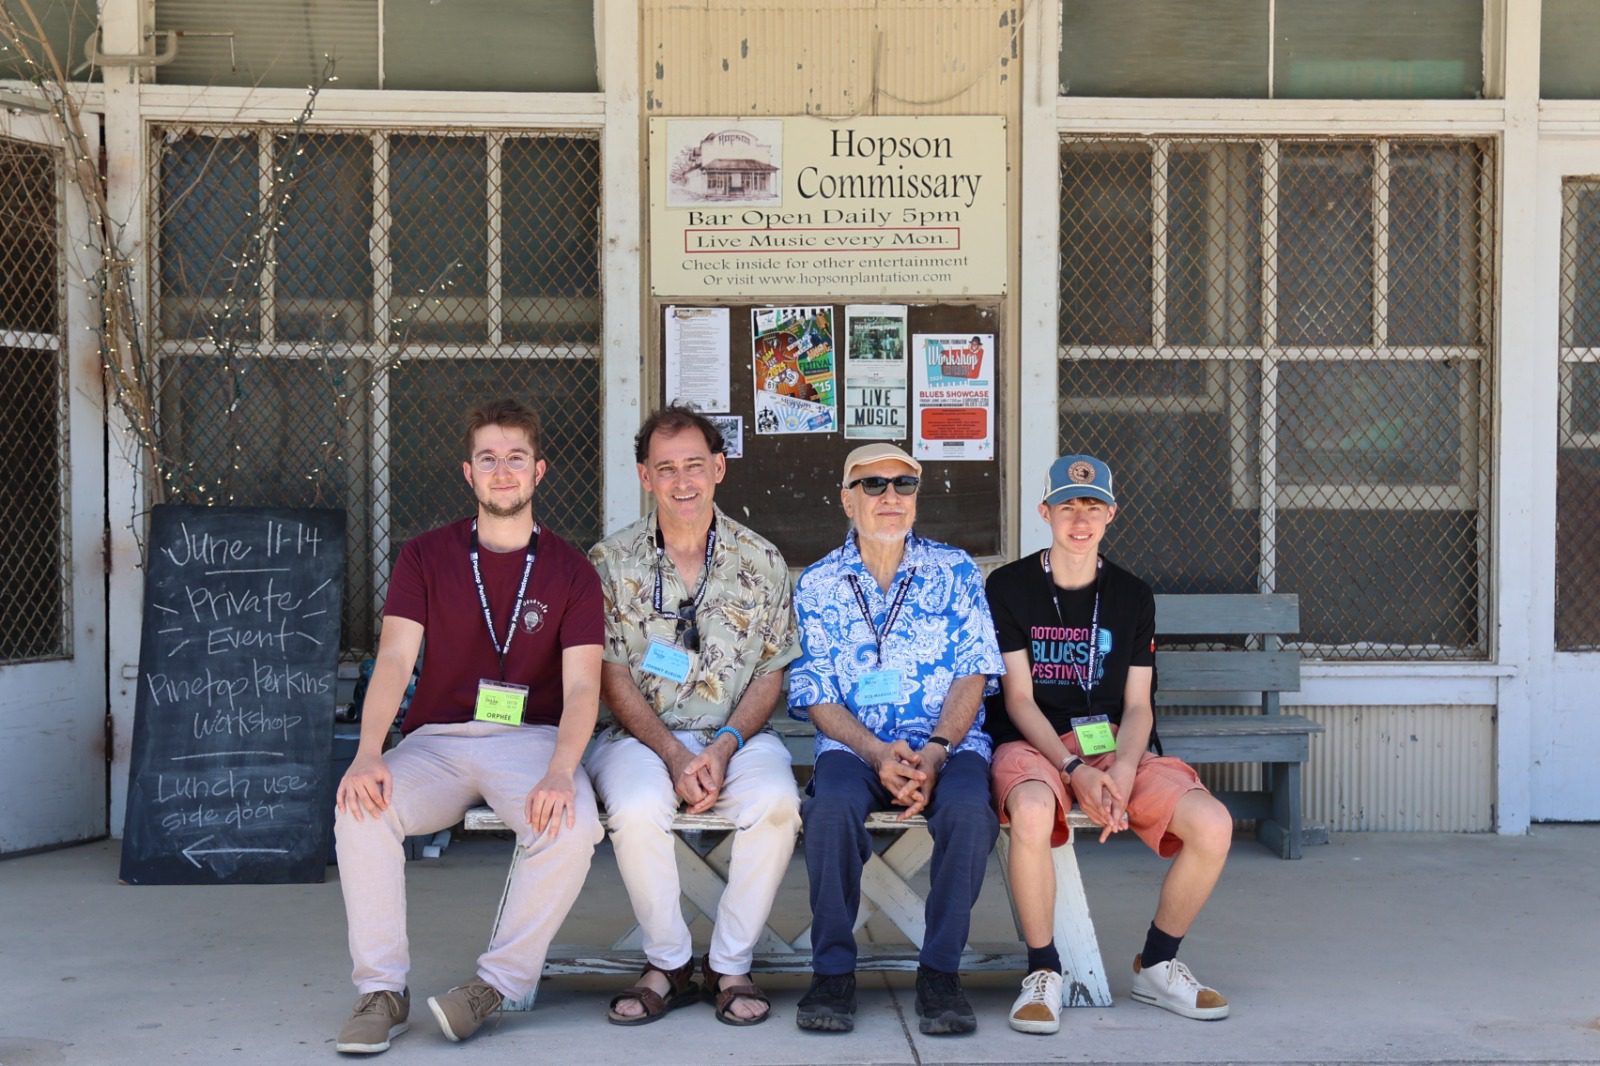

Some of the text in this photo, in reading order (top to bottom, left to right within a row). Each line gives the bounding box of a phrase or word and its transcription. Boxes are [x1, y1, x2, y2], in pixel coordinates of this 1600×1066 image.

[830, 129, 953, 166] Hopson
[797, 165, 983, 208] Commissary
[688, 208, 960, 229] Bar Open Daily 5pm
[697, 233, 949, 249] Live Music every Mon.
[681, 255, 968, 271] Check inside for other entertainment
[703, 271, 952, 287] Or visit www.hopsonplantation.com
[928, 345, 977, 370] Workshop
[862, 389, 891, 406] LIVE
[946, 390, 989, 398] SHOWCASE
[855, 408, 898, 425] MUSIC
[161, 520, 323, 566] June 11-14
[185, 577, 303, 622] Private
[478, 584, 488, 607] Perkins
[207, 617, 295, 655] Event
[1031, 626, 1089, 641] NOTODDEN
[1090, 623, 1098, 646] Perkins
[1032, 640, 1089, 664] BLUES
[1032, 664, 1088, 679] FESTIVAL
[147, 658, 334, 711] Pinetop Perkins
[153, 770, 308, 803] Lunch use
[161, 801, 285, 831] side door
